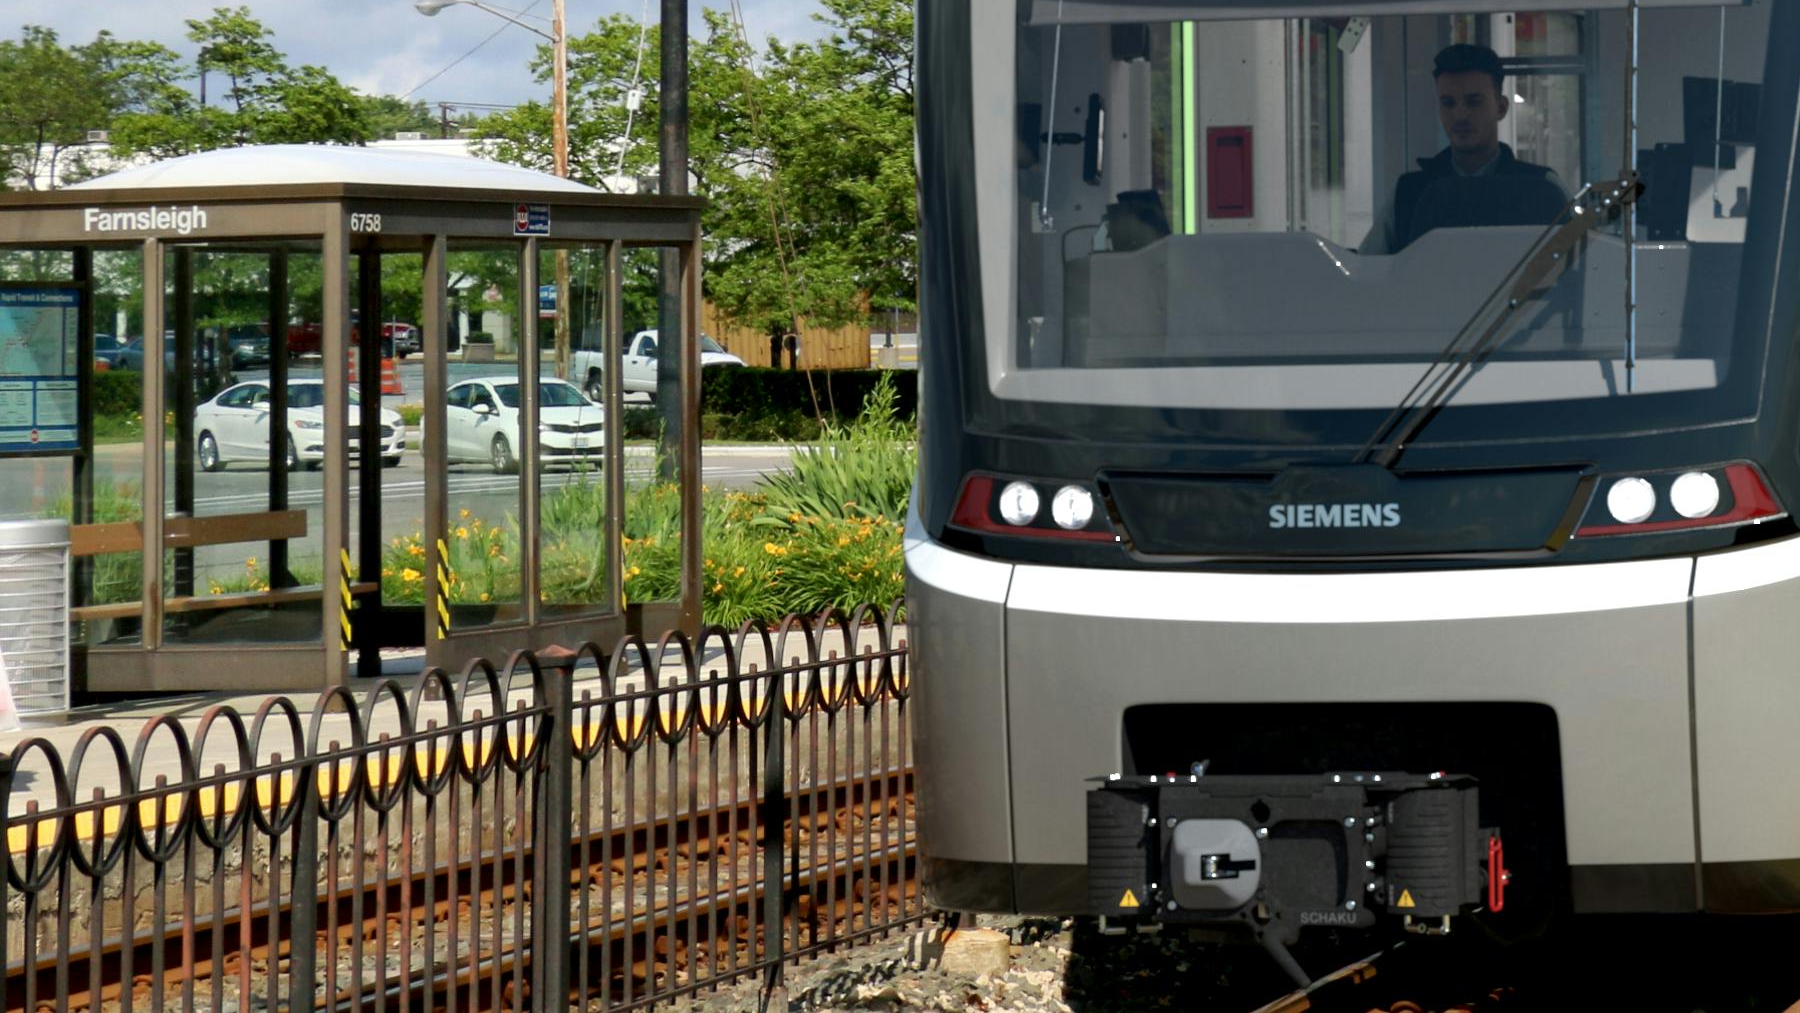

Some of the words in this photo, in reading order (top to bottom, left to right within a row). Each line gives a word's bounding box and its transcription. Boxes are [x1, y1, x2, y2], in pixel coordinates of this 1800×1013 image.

[84, 205, 207, 235] Farnsleigh
[350, 213, 382, 233] 6758
[1269, 502, 1401, 529] SIEMENS
[1300, 911, 1357, 925] SCHAKU
